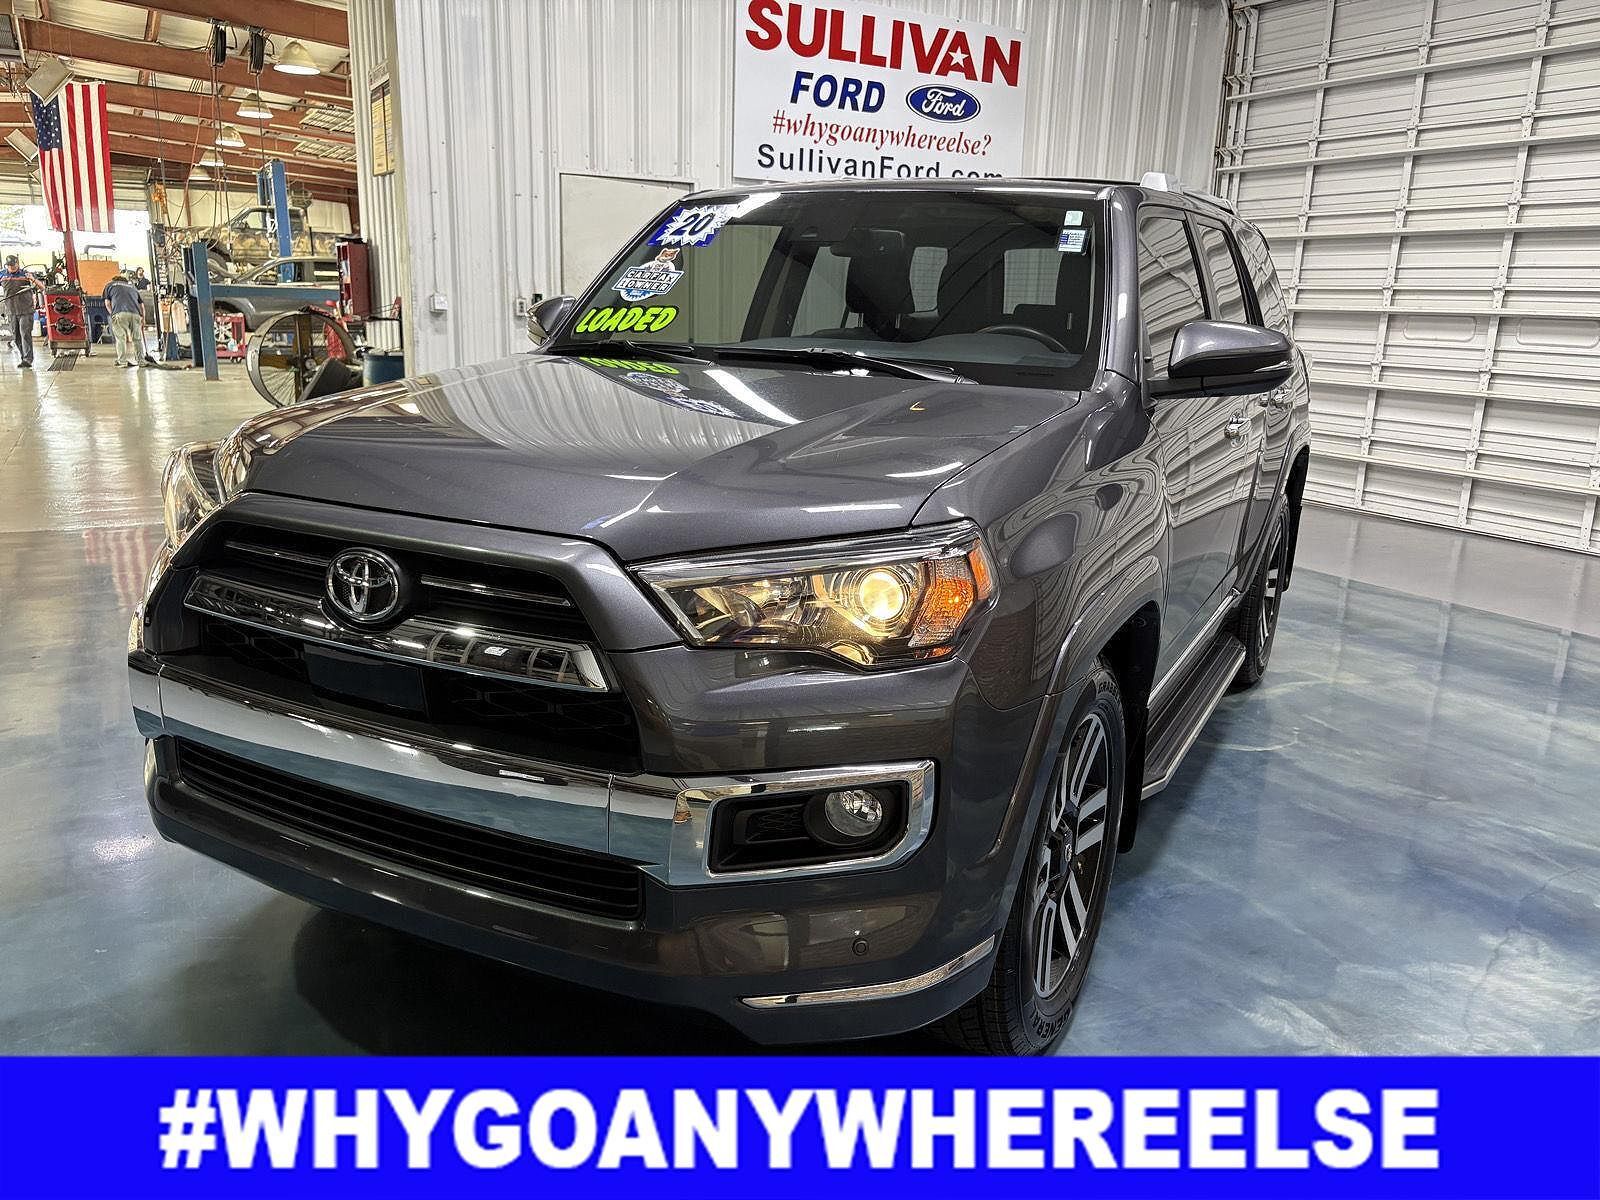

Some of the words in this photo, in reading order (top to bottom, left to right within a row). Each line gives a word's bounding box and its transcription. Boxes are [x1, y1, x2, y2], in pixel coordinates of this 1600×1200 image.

[745, 0, 1022, 87] SULLIVAN
[790, 70, 886, 114] FORD
[772, 109, 992, 156] #whygoanywhereelse?
[757, 143, 1003, 179] SullivanFord
[669, 212, 716, 236] 20
[626, 269, 675, 283] CARFAX
[575, 306, 678, 333] LOADED
